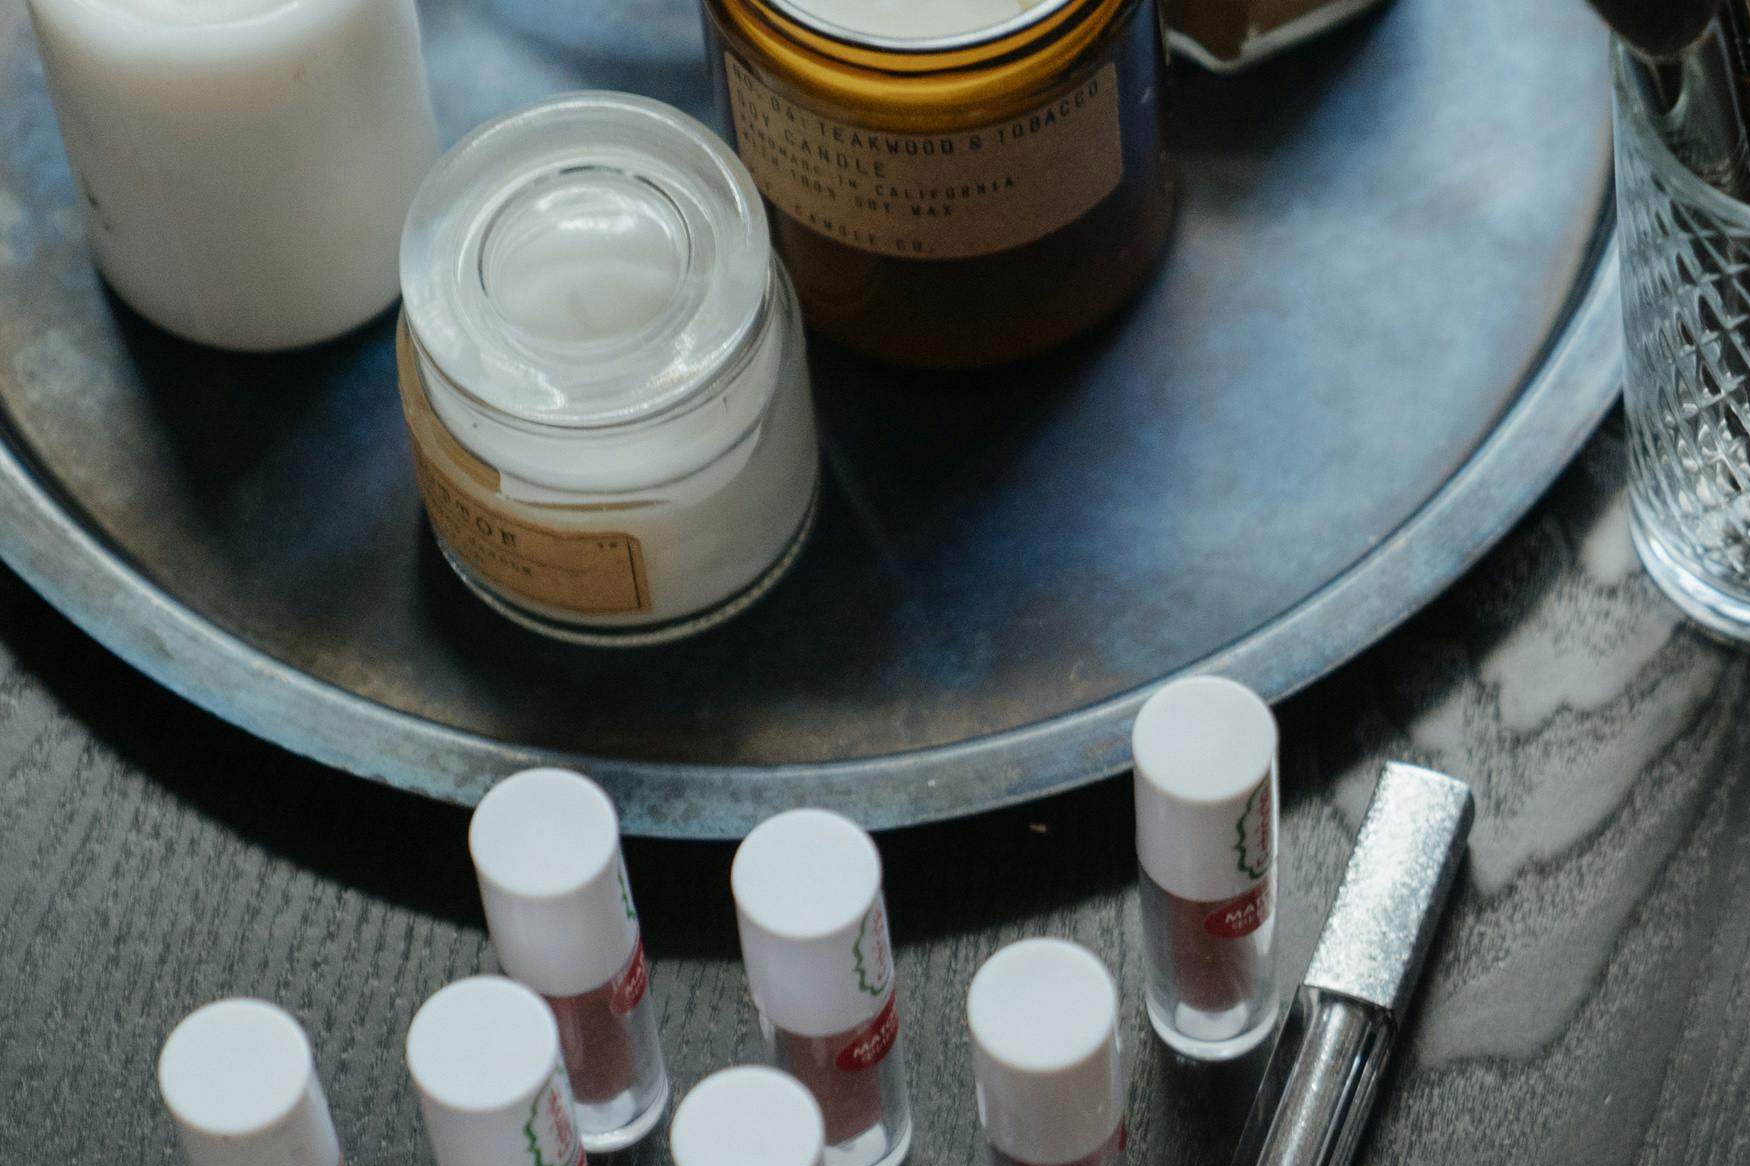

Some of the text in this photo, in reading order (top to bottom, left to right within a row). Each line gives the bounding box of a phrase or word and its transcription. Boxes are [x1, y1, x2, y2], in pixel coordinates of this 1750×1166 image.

[817, 121, 955, 156] TEAKWOOD
[968, 134, 983, 151] &
[997, 79, 1099, 145] TOBACCO
[784, 128, 887, 179] CANDLE
[875, 176, 1015, 200] CALIFORNIA
[911, 204, 953, 217] WAX
